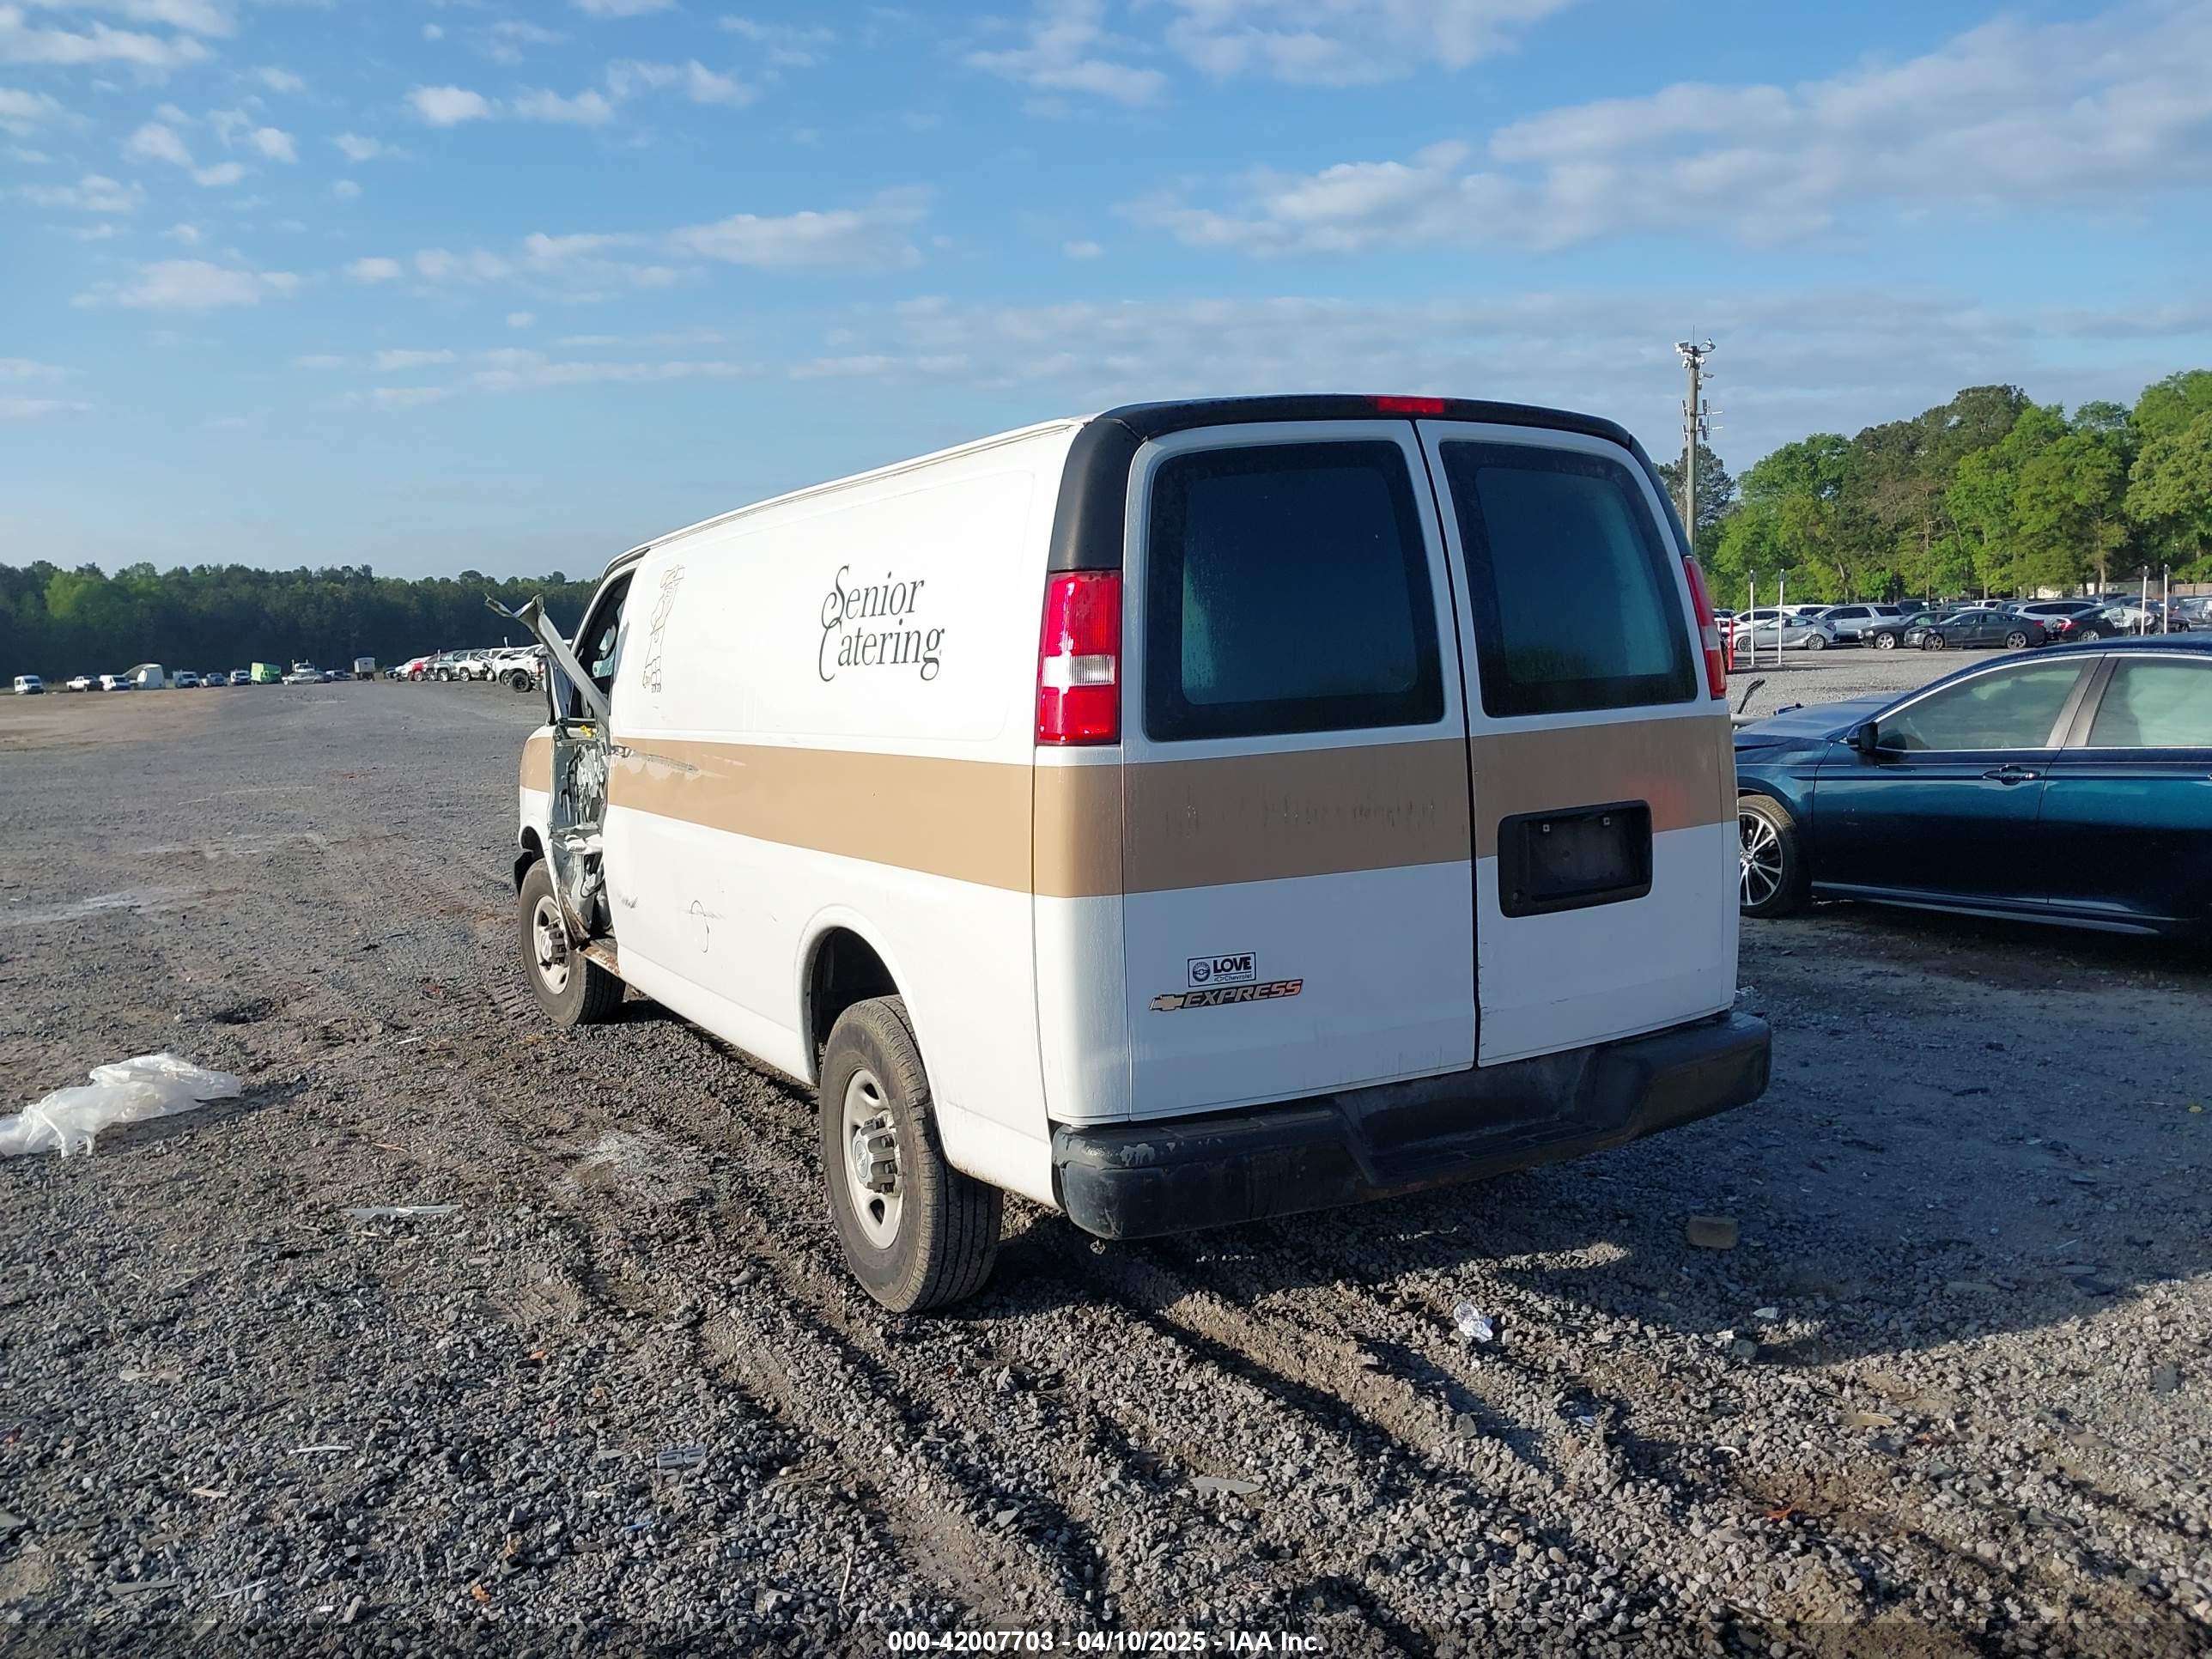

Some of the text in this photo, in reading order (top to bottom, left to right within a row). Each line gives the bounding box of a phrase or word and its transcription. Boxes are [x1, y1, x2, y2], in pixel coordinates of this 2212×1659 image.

[822, 564, 925, 629] Senior
[819, 617, 945, 681] Catering
[1213, 956, 1252, 973] LOVE
[1185, 981, 1301, 1007] EXPRESS
